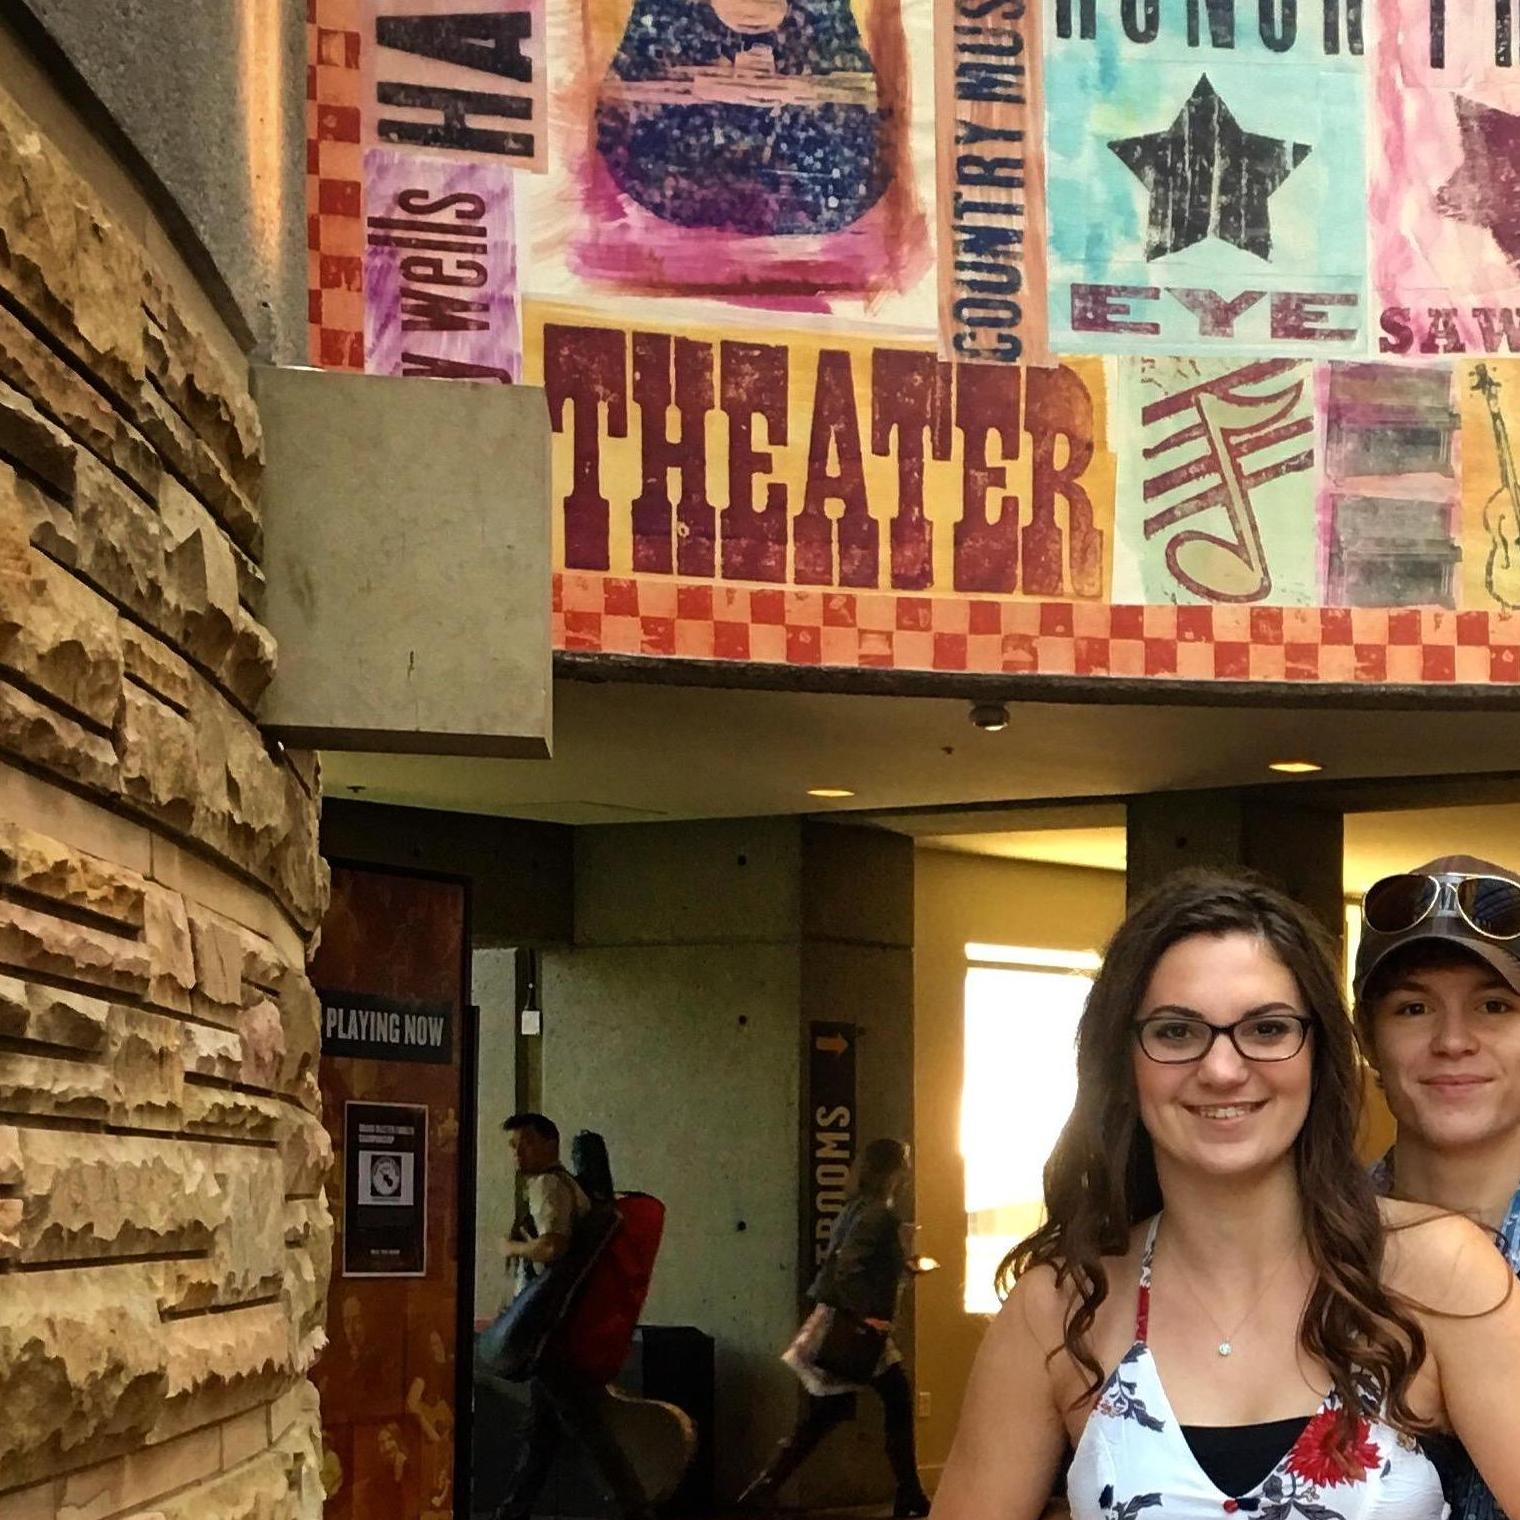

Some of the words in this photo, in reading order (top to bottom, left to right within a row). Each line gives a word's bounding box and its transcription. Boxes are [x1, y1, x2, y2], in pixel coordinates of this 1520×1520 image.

[367, 189, 490, 331] wells
[952, 119, 1026, 362] COUNTRY
[1070, 282, 1359, 341] EYE
[543, 323, 1104, 597] THEATER
[326, 1006, 400, 1044] PLAYING
[404, 1013, 444, 1047] NOW
